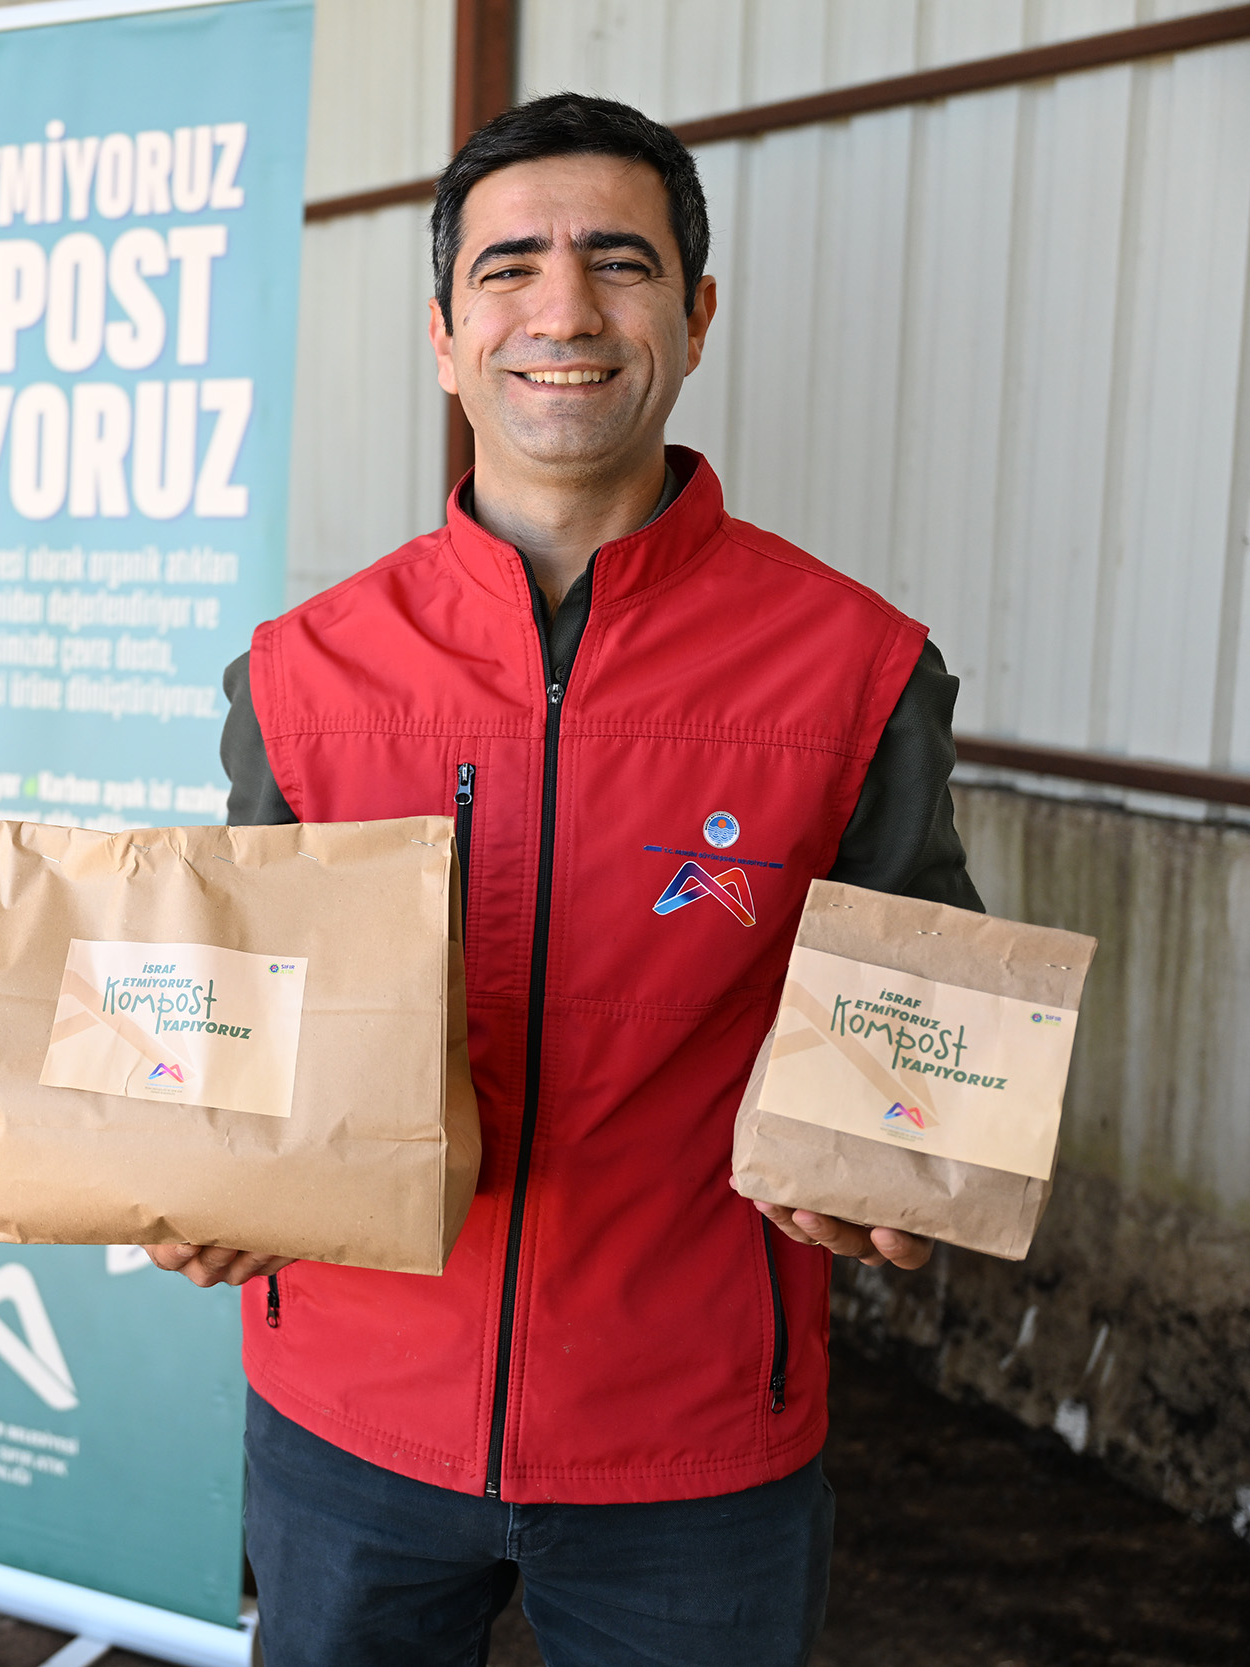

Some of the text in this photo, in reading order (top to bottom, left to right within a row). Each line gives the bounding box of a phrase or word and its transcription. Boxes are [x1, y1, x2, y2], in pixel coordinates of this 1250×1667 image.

[142, 961, 176, 974] İSRAF
[122, 975, 193, 989] ETMİYORUZ
[879, 987, 922, 1010] İSRAF
[854, 999, 941, 1031] ETMİYORUZ
[162, 1019, 252, 1040] YAPIYORUZ
[900, 1055, 1008, 1091] YAPIYORUZ
